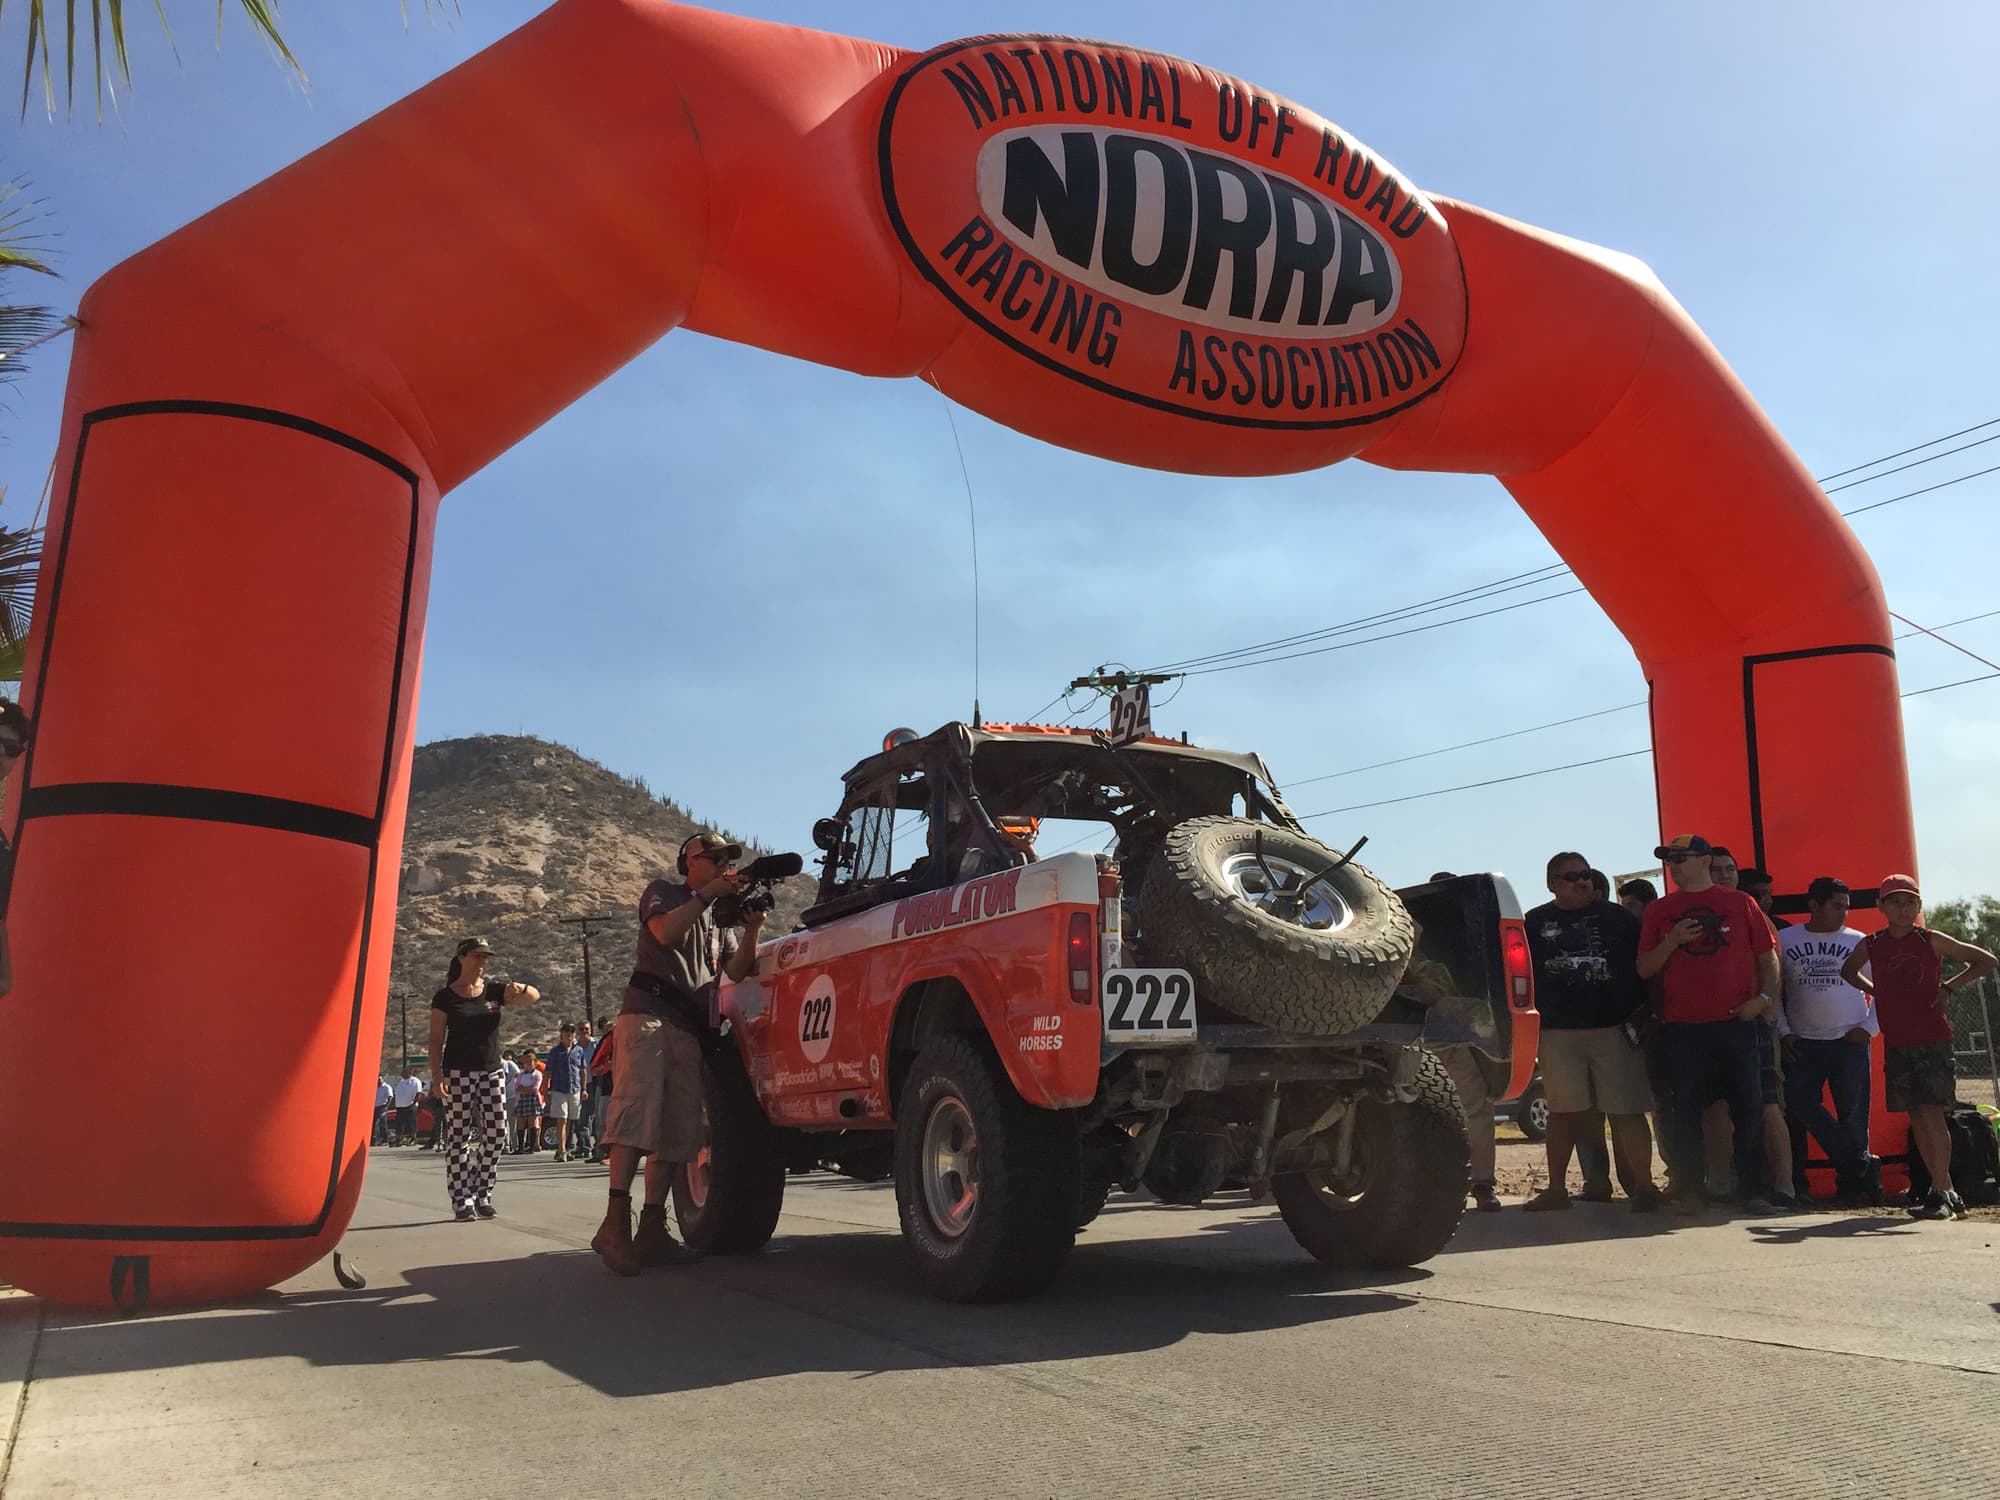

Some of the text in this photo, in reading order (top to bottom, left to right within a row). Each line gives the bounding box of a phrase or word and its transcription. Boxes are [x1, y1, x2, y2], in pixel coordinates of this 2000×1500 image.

[941, 48, 1428, 239] NATIONAL OFF ROAD
[1002, 131, 1394, 326] NORRA
[941, 215, 1442, 410] RACING ASSOCIATION
[1110, 683, 1150, 741] 222
[891, 868, 1021, 939] PUROLATOR
[1786, 942, 1853, 960] OLD NAVY
[802, 996, 832, 1042] 222
[1033, 1015, 1061, 1032] WILD
[1107, 974, 1193, 1030] 222
[1019, 1034, 1063, 1052] HORSES
